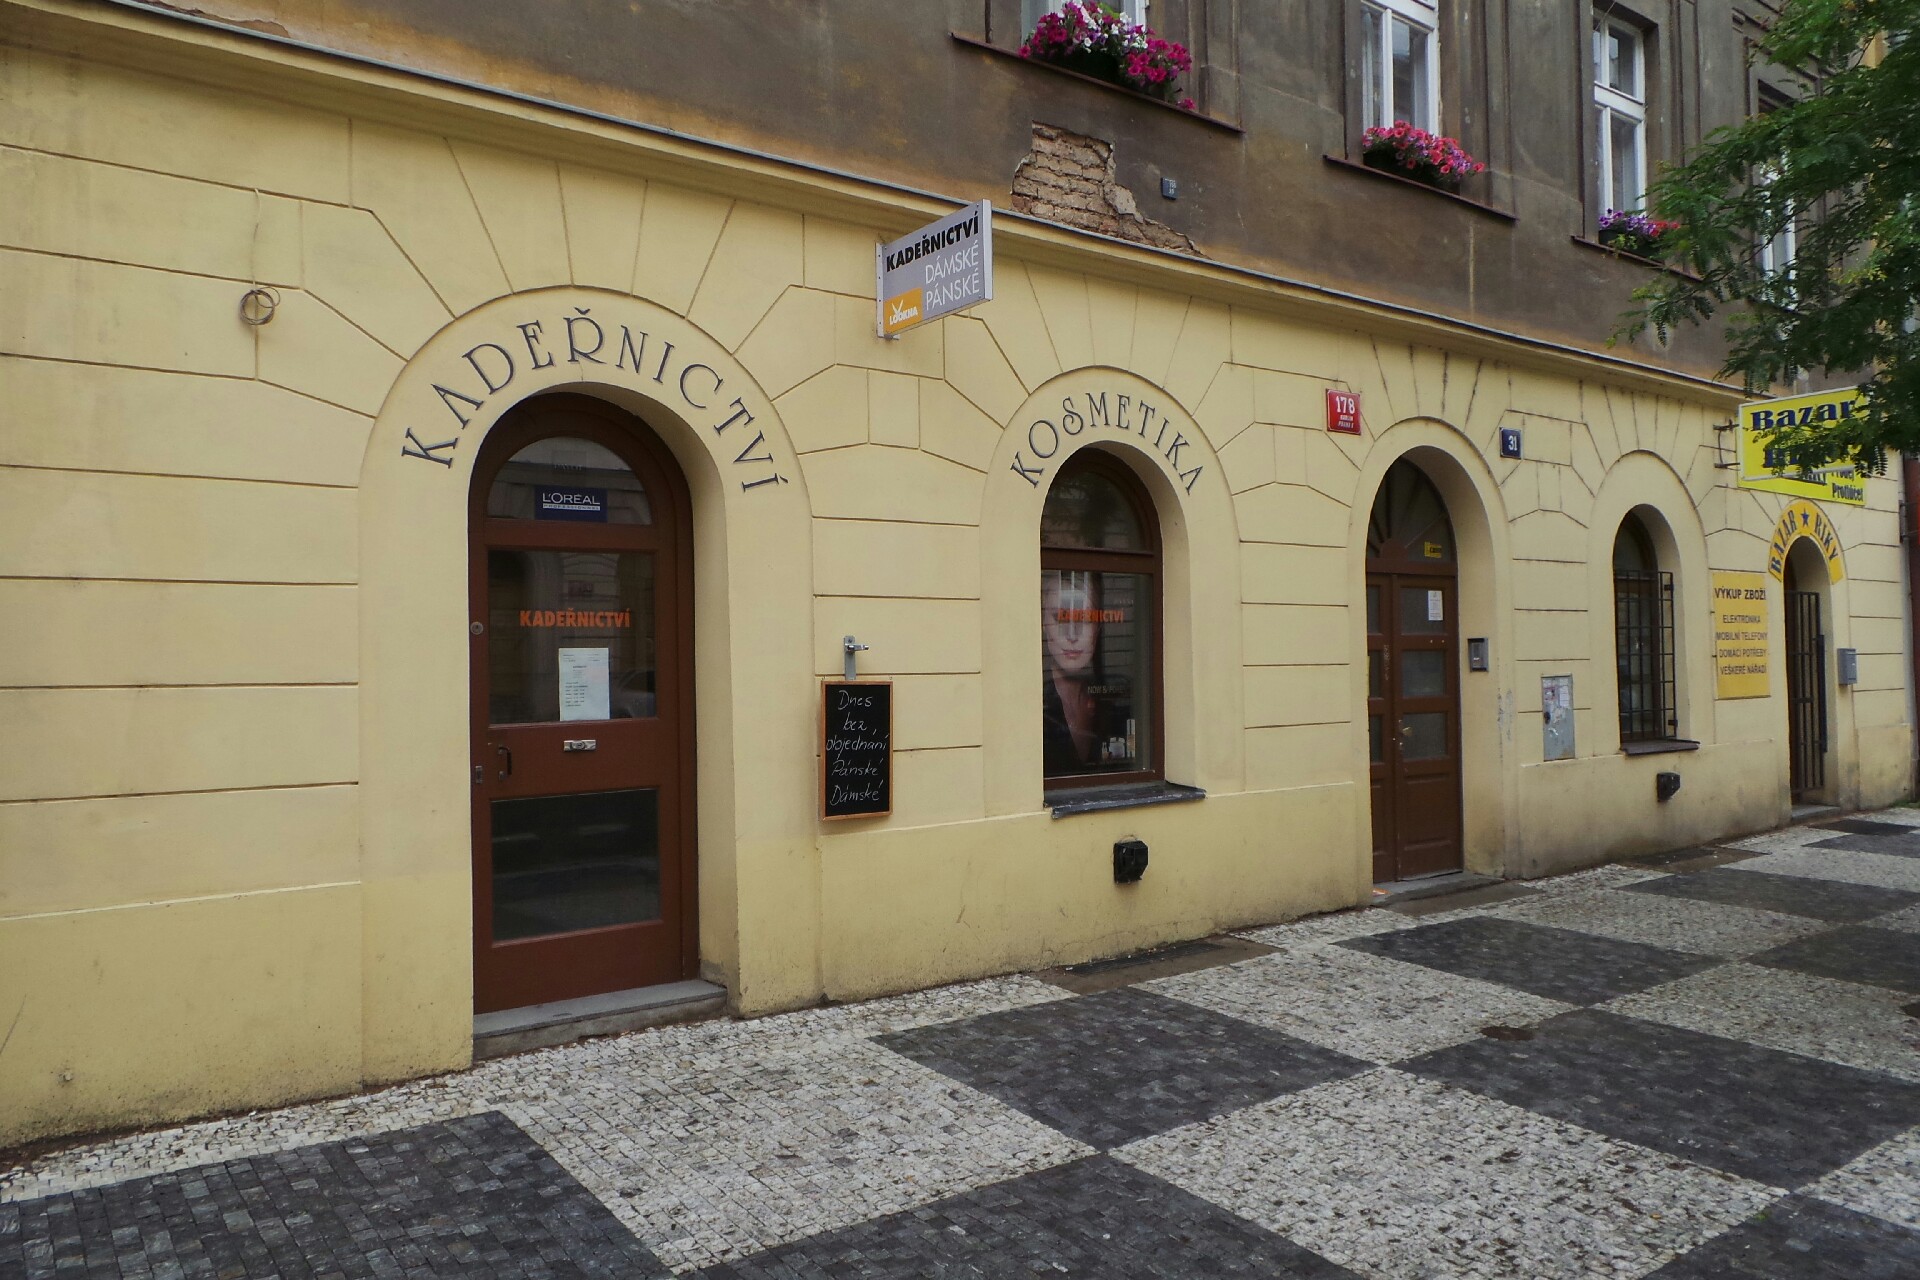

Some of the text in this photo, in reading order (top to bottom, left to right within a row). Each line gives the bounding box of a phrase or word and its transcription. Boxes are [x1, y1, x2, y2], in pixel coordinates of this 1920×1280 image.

[886, 211, 979, 272] KADEŘNICTVÍ
[925, 240, 979, 284] DÁMSKÉ
[926, 268, 980, 311] PÁNSKÉ
[401, 307, 789, 493] KADEŘNICTVÍ
[1335, 395, 1356, 414] 178
[1750, 400, 1857, 431] Bazar
[1009, 391, 1205, 495] KOSMETIKA
[1508, 435, 1518, 451] 31
[542, 492, 601, 505] L'ORÉAL
[1770, 509, 1839, 574] BAZAR RIKY
[1714, 586, 1766, 601] VÝKUP ZBOŽÍ
[520, 607, 631, 628] KADEŘNICTVÍ
[1723, 614, 1761, 624] ELEKTRONIKA
[838, 689, 873, 711] Dnes
[843, 712, 868, 731] bez
[826, 728, 890, 761] objednání
[831, 758, 884, 777] Pánské
[829, 779, 884, 806] Dámské
